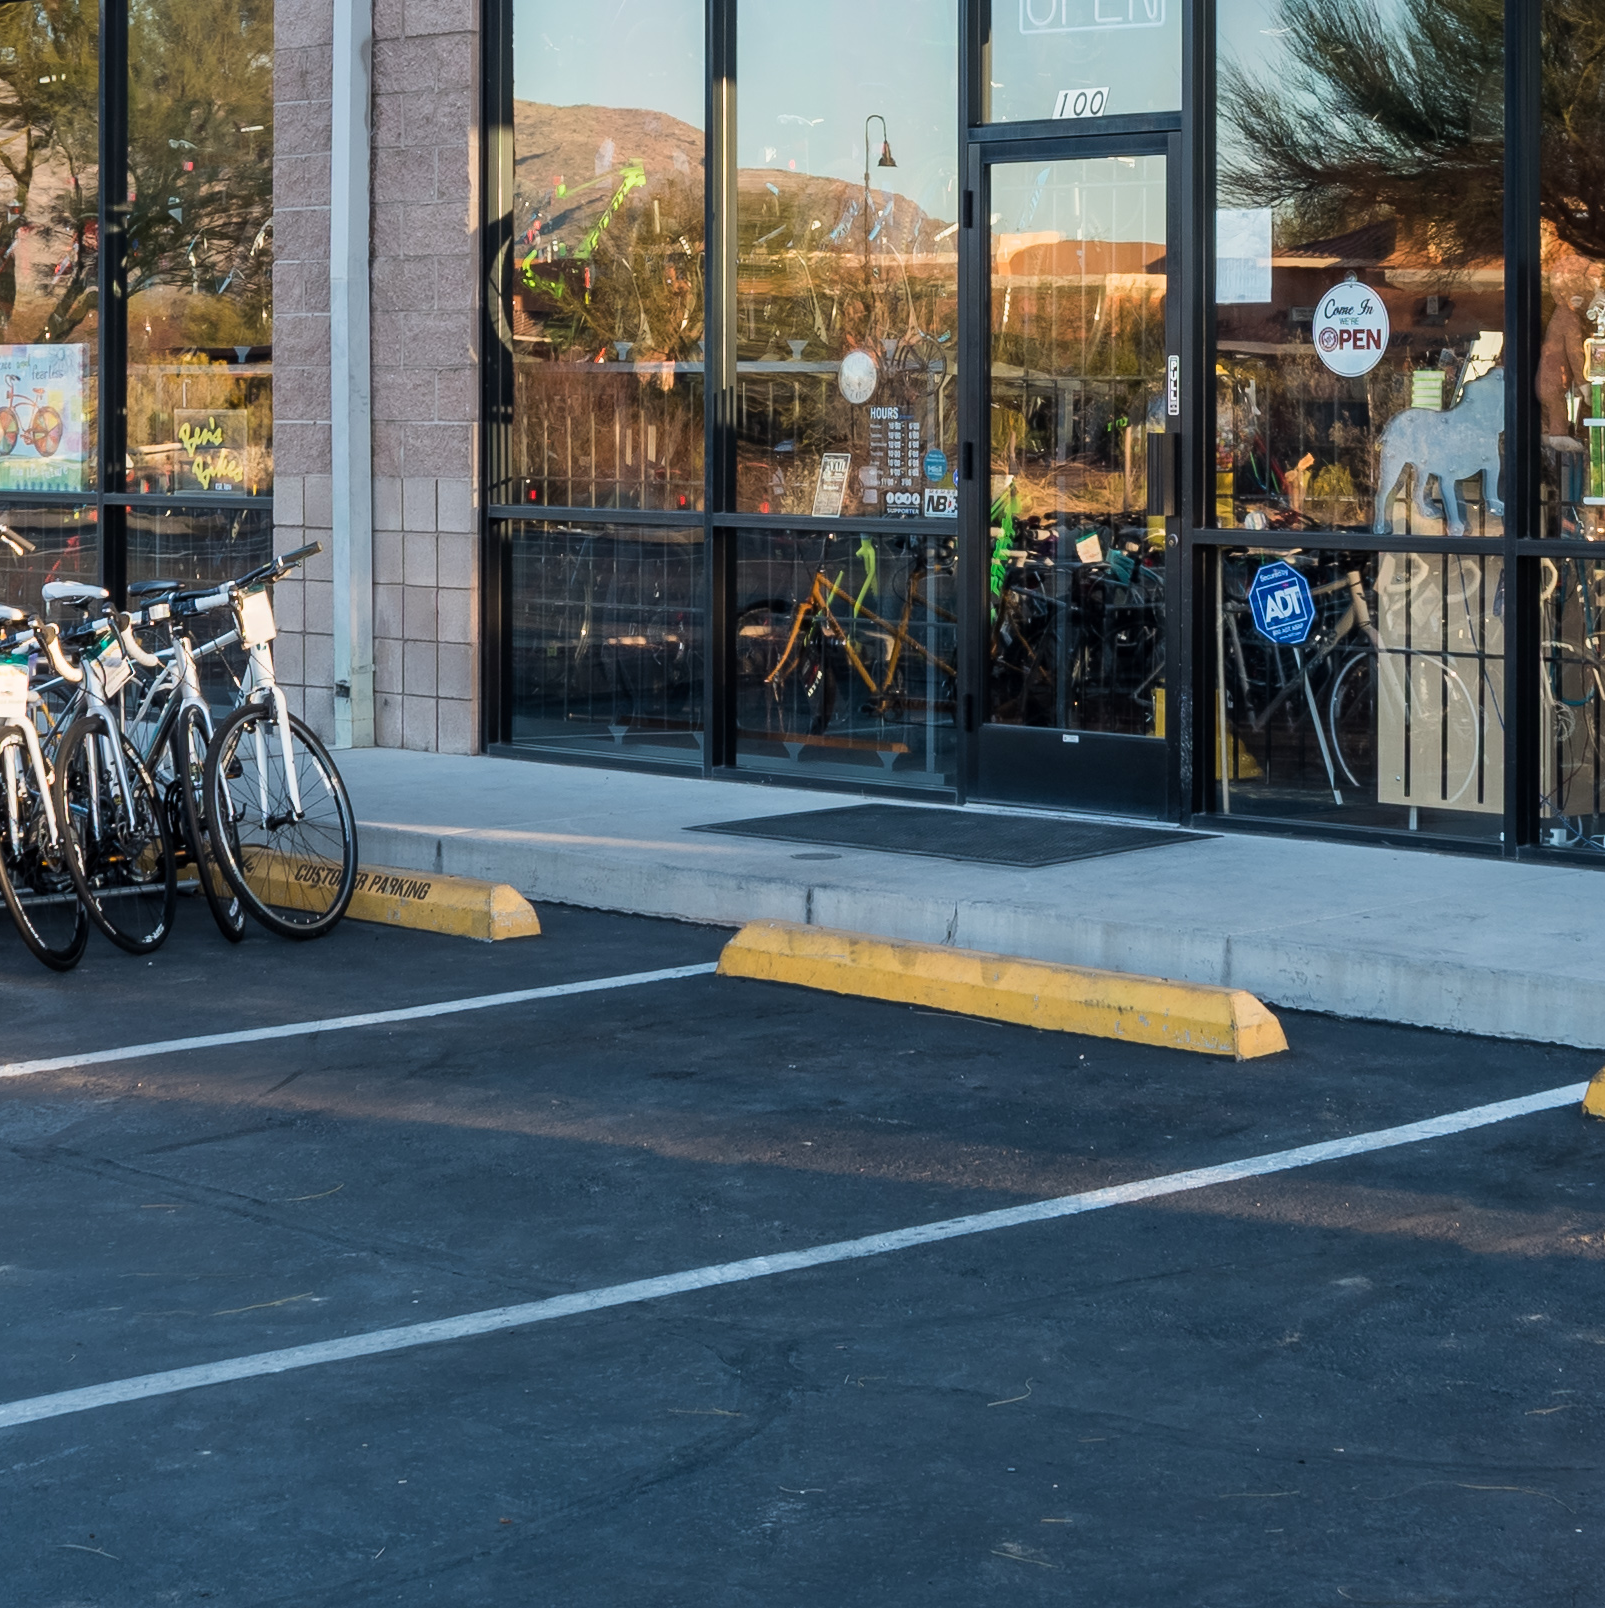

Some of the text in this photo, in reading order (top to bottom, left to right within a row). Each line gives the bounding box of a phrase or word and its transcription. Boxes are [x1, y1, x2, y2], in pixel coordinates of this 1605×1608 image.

[1059, 90, 1104, 117] 100
[1324, 298, 1374, 319] Come In
[1318, 326, 1381, 352] OPEN
[31, 365, 64, 380] fearless
[1170, 360, 1178, 401] PULL
[870, 406, 899, 420] HOURS
[178, 416, 223, 458] Ben's
[191, 448, 244, 491] Bikes
[1265, 585, 1302, 623] ADT
[294, 863, 432, 900] CUSTOER PARKING
